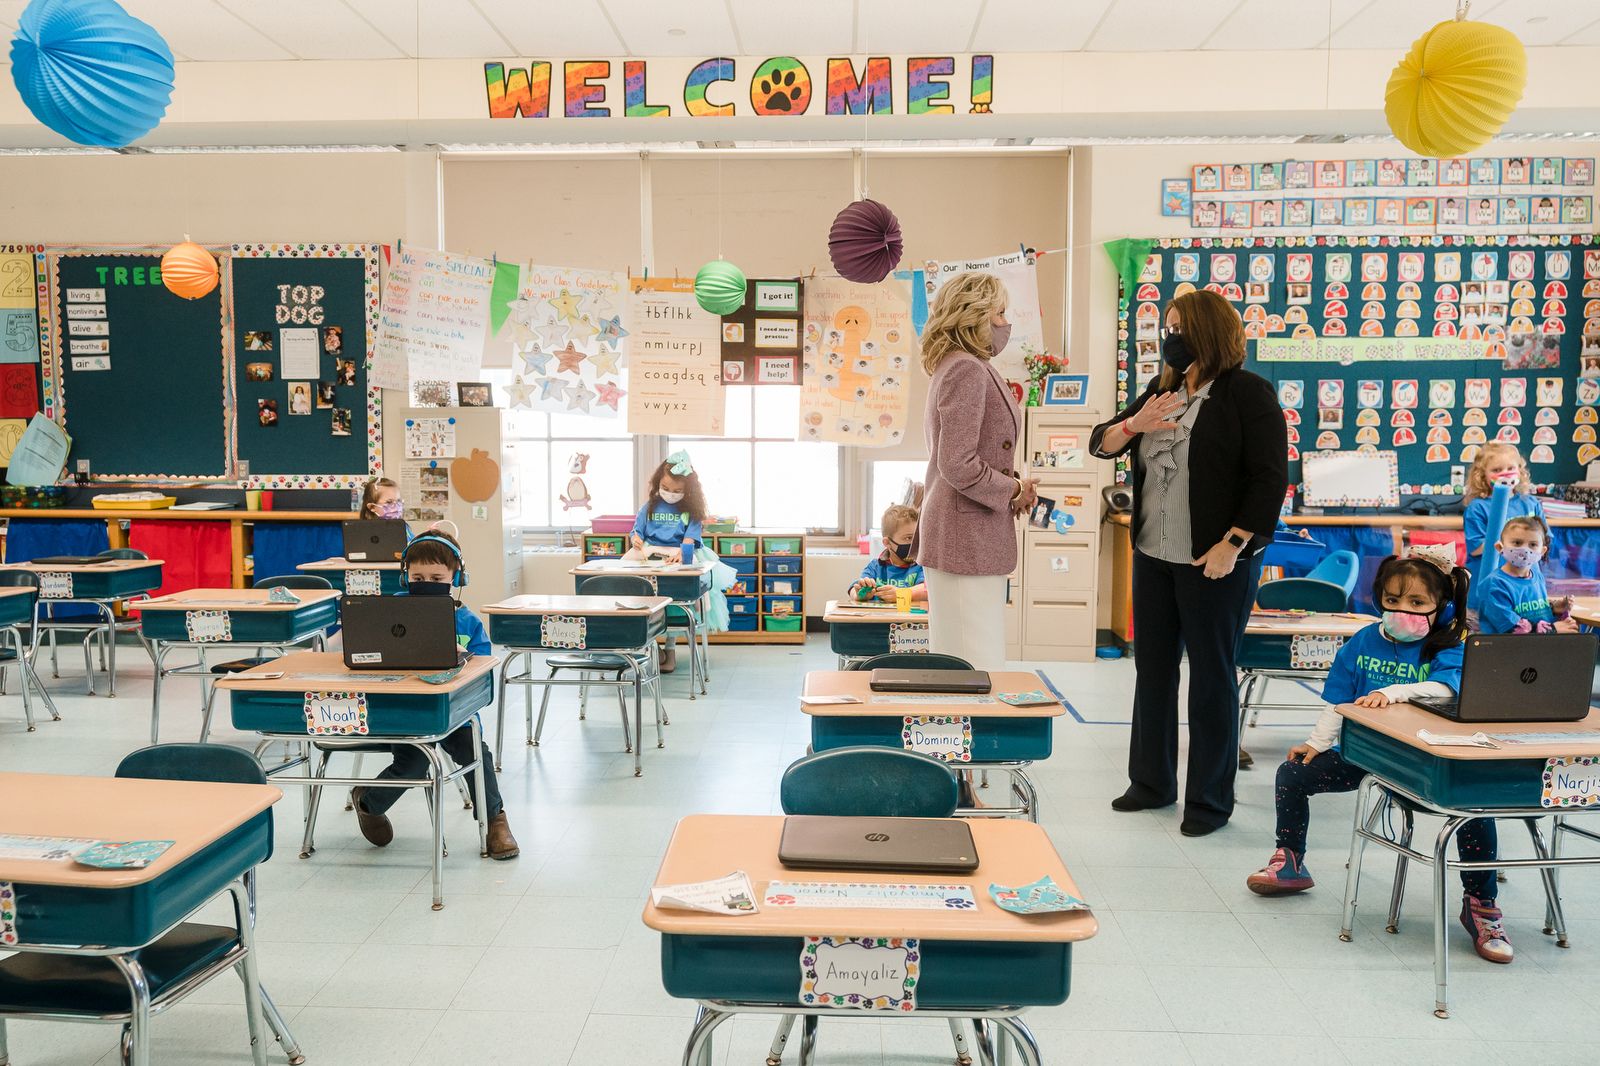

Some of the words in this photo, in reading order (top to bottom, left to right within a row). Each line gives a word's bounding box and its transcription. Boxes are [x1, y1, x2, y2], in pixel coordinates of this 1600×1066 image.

[484, 55, 993, 118] WELCOME!
[402, 254, 416, 266] We
[425, 260, 442, 271] are
[446, 262, 492, 278] SPECIAL!
[943, 264, 958, 273] Our
[965, 262, 990, 270] Name
[997, 255, 1022, 266] Chart
[1293, 264, 1305, 276] Ee
[1332, 263, 1344, 276] Ff
[1403, 263, 1418, 276] Hh
[1514, 263, 1528, 274] Kk
[1553, 262, 1564, 274] Ll
[1142, 266, 1157, 277] Aa
[1179, 265, 1193, 276] Bb
[1216, 265, 1231, 276] Cc
[1254, 265, 1269, 276] Dd
[1366, 264, 1381, 279] Gg
[1477, 263, 1489, 279] Jj
[2, 259, 33, 297] 2
[533, 273, 548, 285] Our
[70, 291, 91, 301] living
[276, 284, 325, 304] TOP
[541, 290, 556, 300] will
[68, 308, 98, 317] nonliving
[275, 305, 325, 325] DOG
[5, 313, 36, 352] 5
[71, 324, 91, 332] alive
[71, 342, 100, 351] breathe
[413, 339, 426, 347] can
[431, 341, 450, 351] swim
[1258, 340, 1354, 366] barking
[75, 359, 90, 368] air
[767, 371, 788, 379] help!
[1284, 391, 1297, 402] Rr
[1325, 390, 1337, 402] Ss
[1363, 391, 1376, 402] Tt
[1398, 391, 1411, 402] Uu
[1435, 391, 1447, 402] Vv
[1469, 390, 1484, 401] Ww
[1507, 390, 1519, 401] Xx
[1542, 388, 1555, 401] Yy
[1582, 388, 1595, 401] Zz
[391, 624, 406, 638] hp
[551, 626, 577, 639] Alexis
[896, 635, 929, 645] Jameson
[1301, 643, 1335, 657] Jehiel
[1520, 667, 1538, 684] hp
[320, 705, 357, 722] Noah
[915, 730, 961, 746] Dominic
[864, 832, 890, 843] hp
[826, 961, 899, 987] Amayaliz
